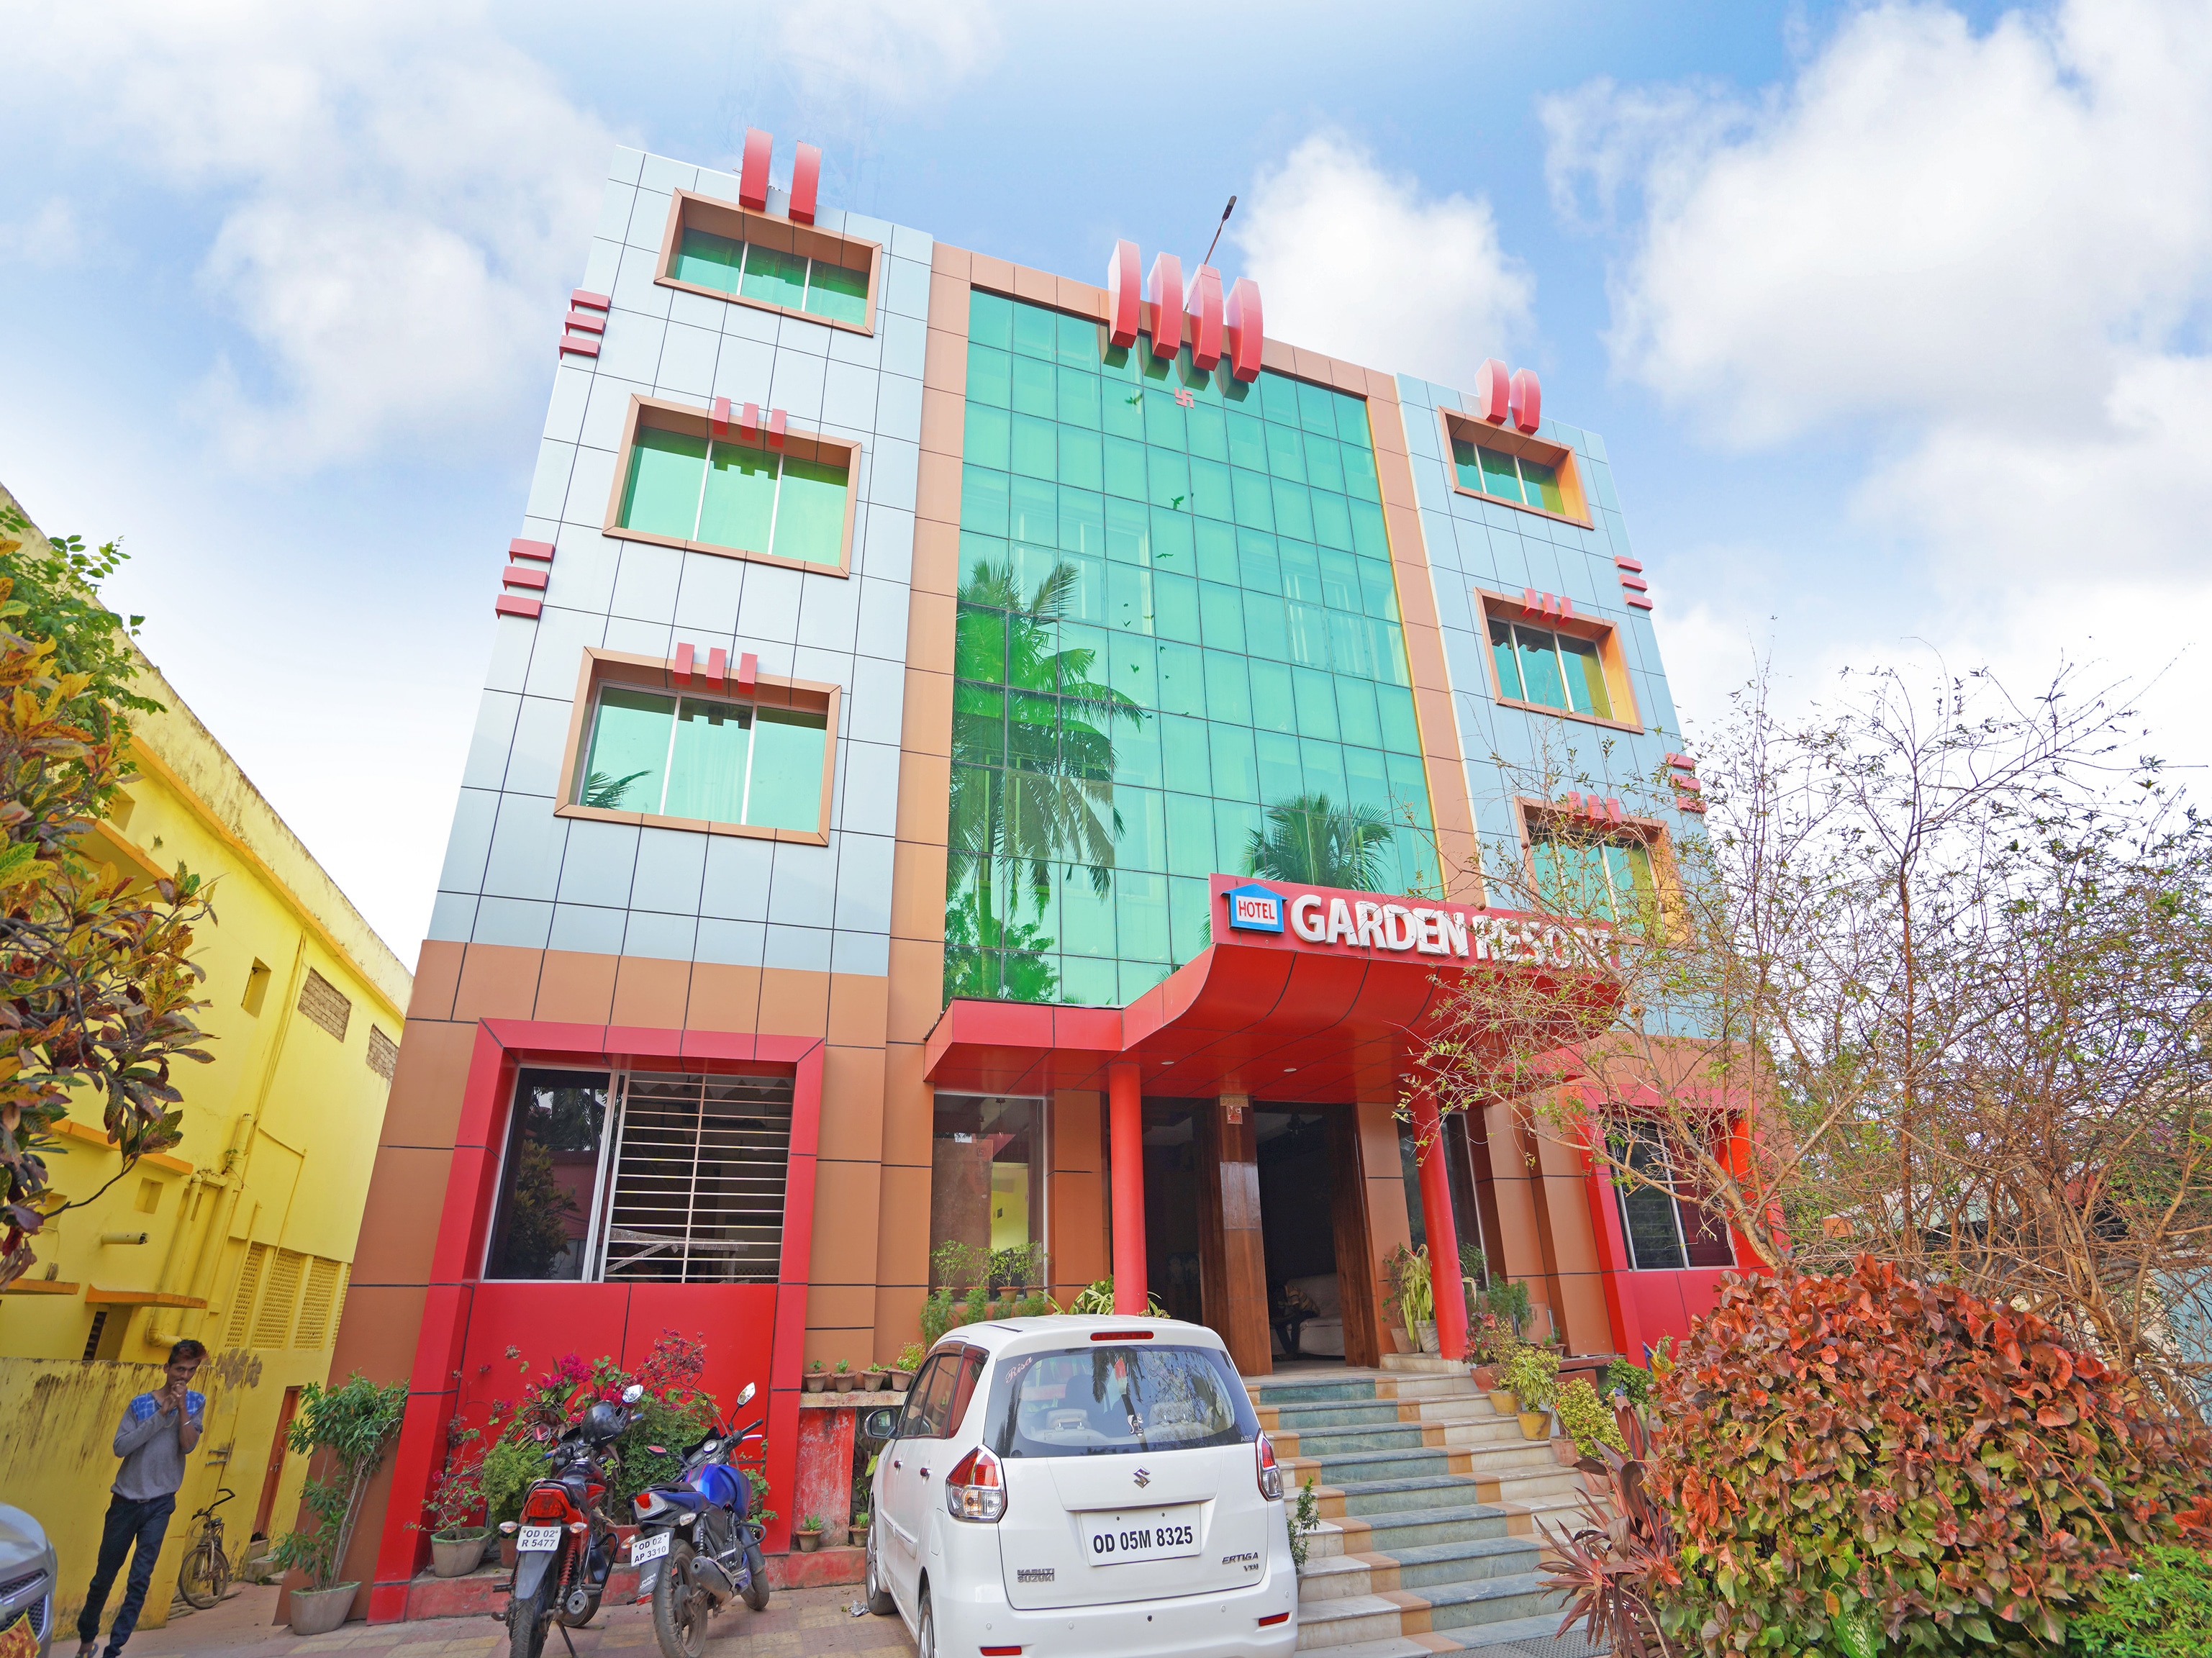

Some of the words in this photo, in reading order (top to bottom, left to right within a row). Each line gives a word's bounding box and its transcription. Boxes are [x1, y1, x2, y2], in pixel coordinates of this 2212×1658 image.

[1238, 900, 1275, 920] HOTEL
[1290, 894, 1469, 958] GARDEN
[1005, 1356, 1033, 1383] Risa
[639, 1541, 651, 1550] OD
[652, 1536, 662, 1545] 02
[1093, 1534, 1115, 1554] OD
[1120, 1530, 1151, 1551] 05M
[1156, 1526, 1193, 1547] 8325
[634, 1553, 645, 1563] AP
[647, 1545, 666, 1558] 3310
[1222, 1551, 1259, 1564] ERTIGA
[1017, 1574, 1055, 1582] SUZUKI
